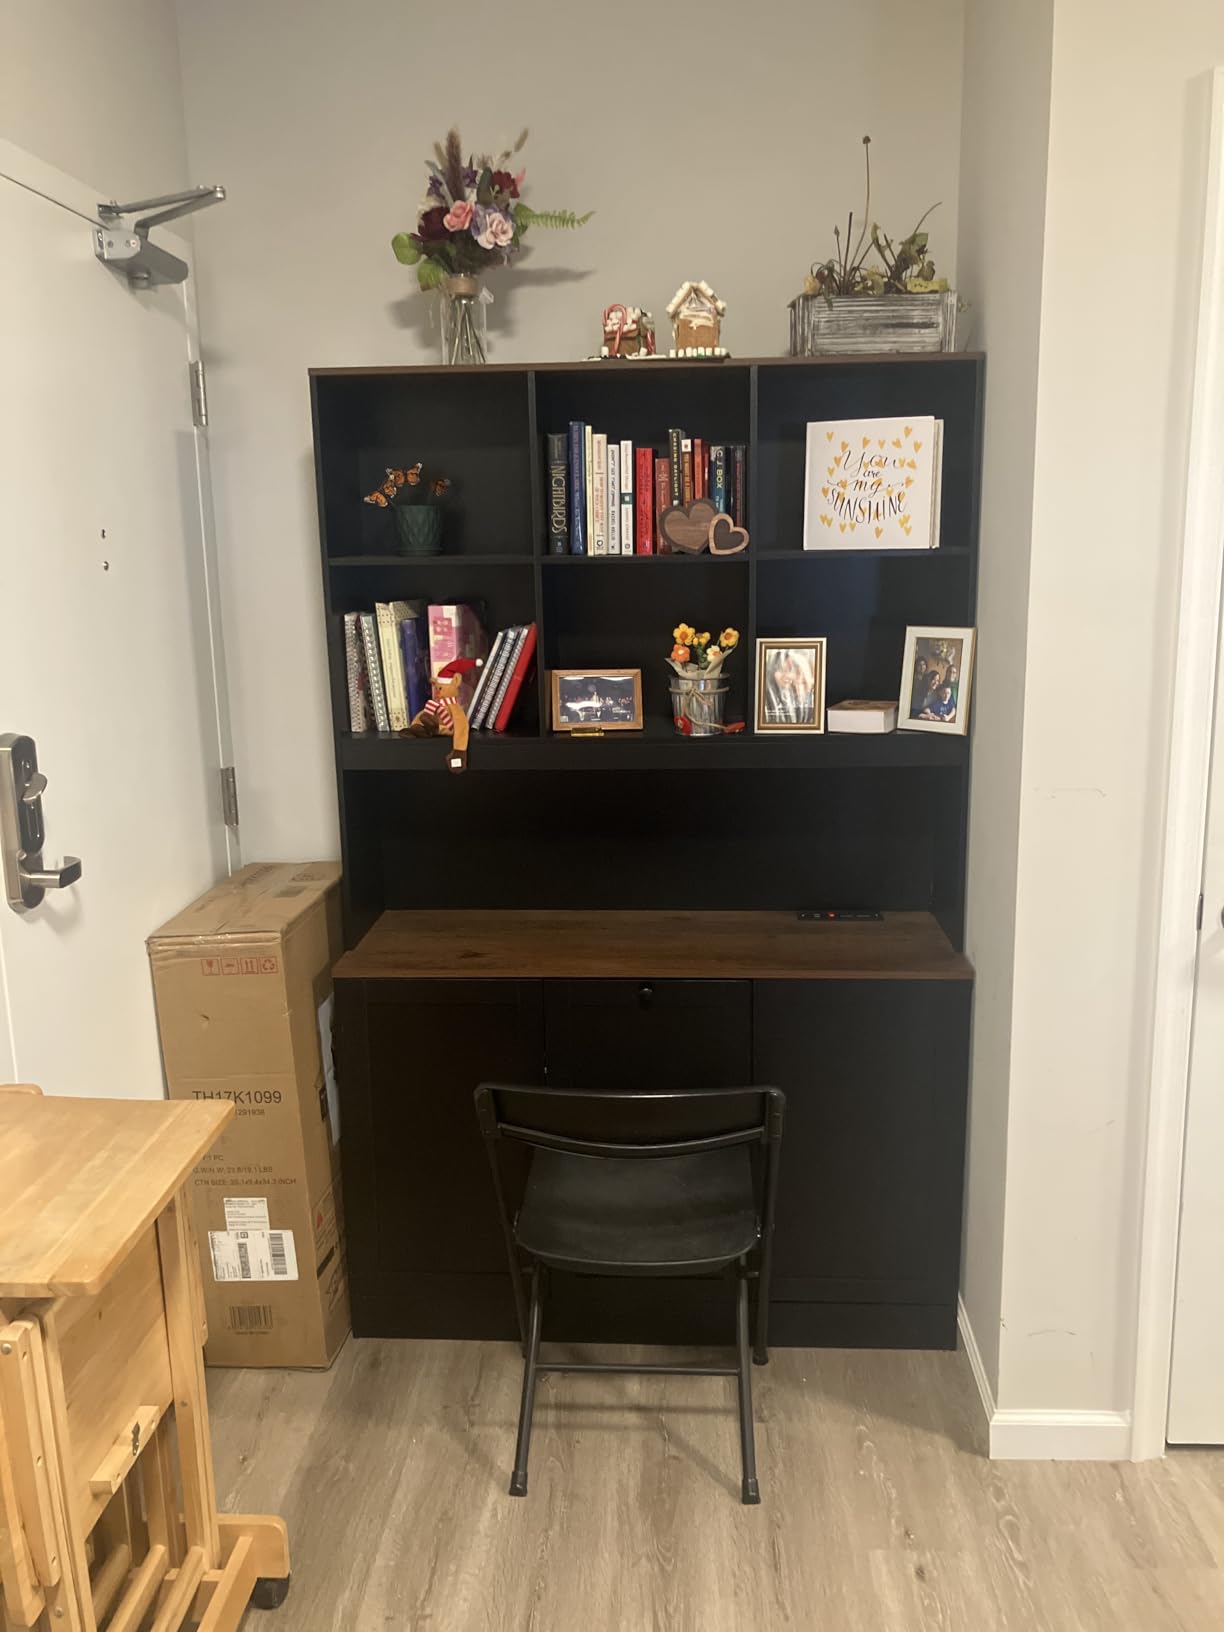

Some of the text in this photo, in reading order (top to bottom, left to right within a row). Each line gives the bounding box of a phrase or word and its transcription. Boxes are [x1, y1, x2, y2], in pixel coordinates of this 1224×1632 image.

[550, 465, 567, 534] NIGHTBIRDS
[826, 488, 907, 524] SUNSHINE
[192, 1090, 282, 1104] TH17K1099
